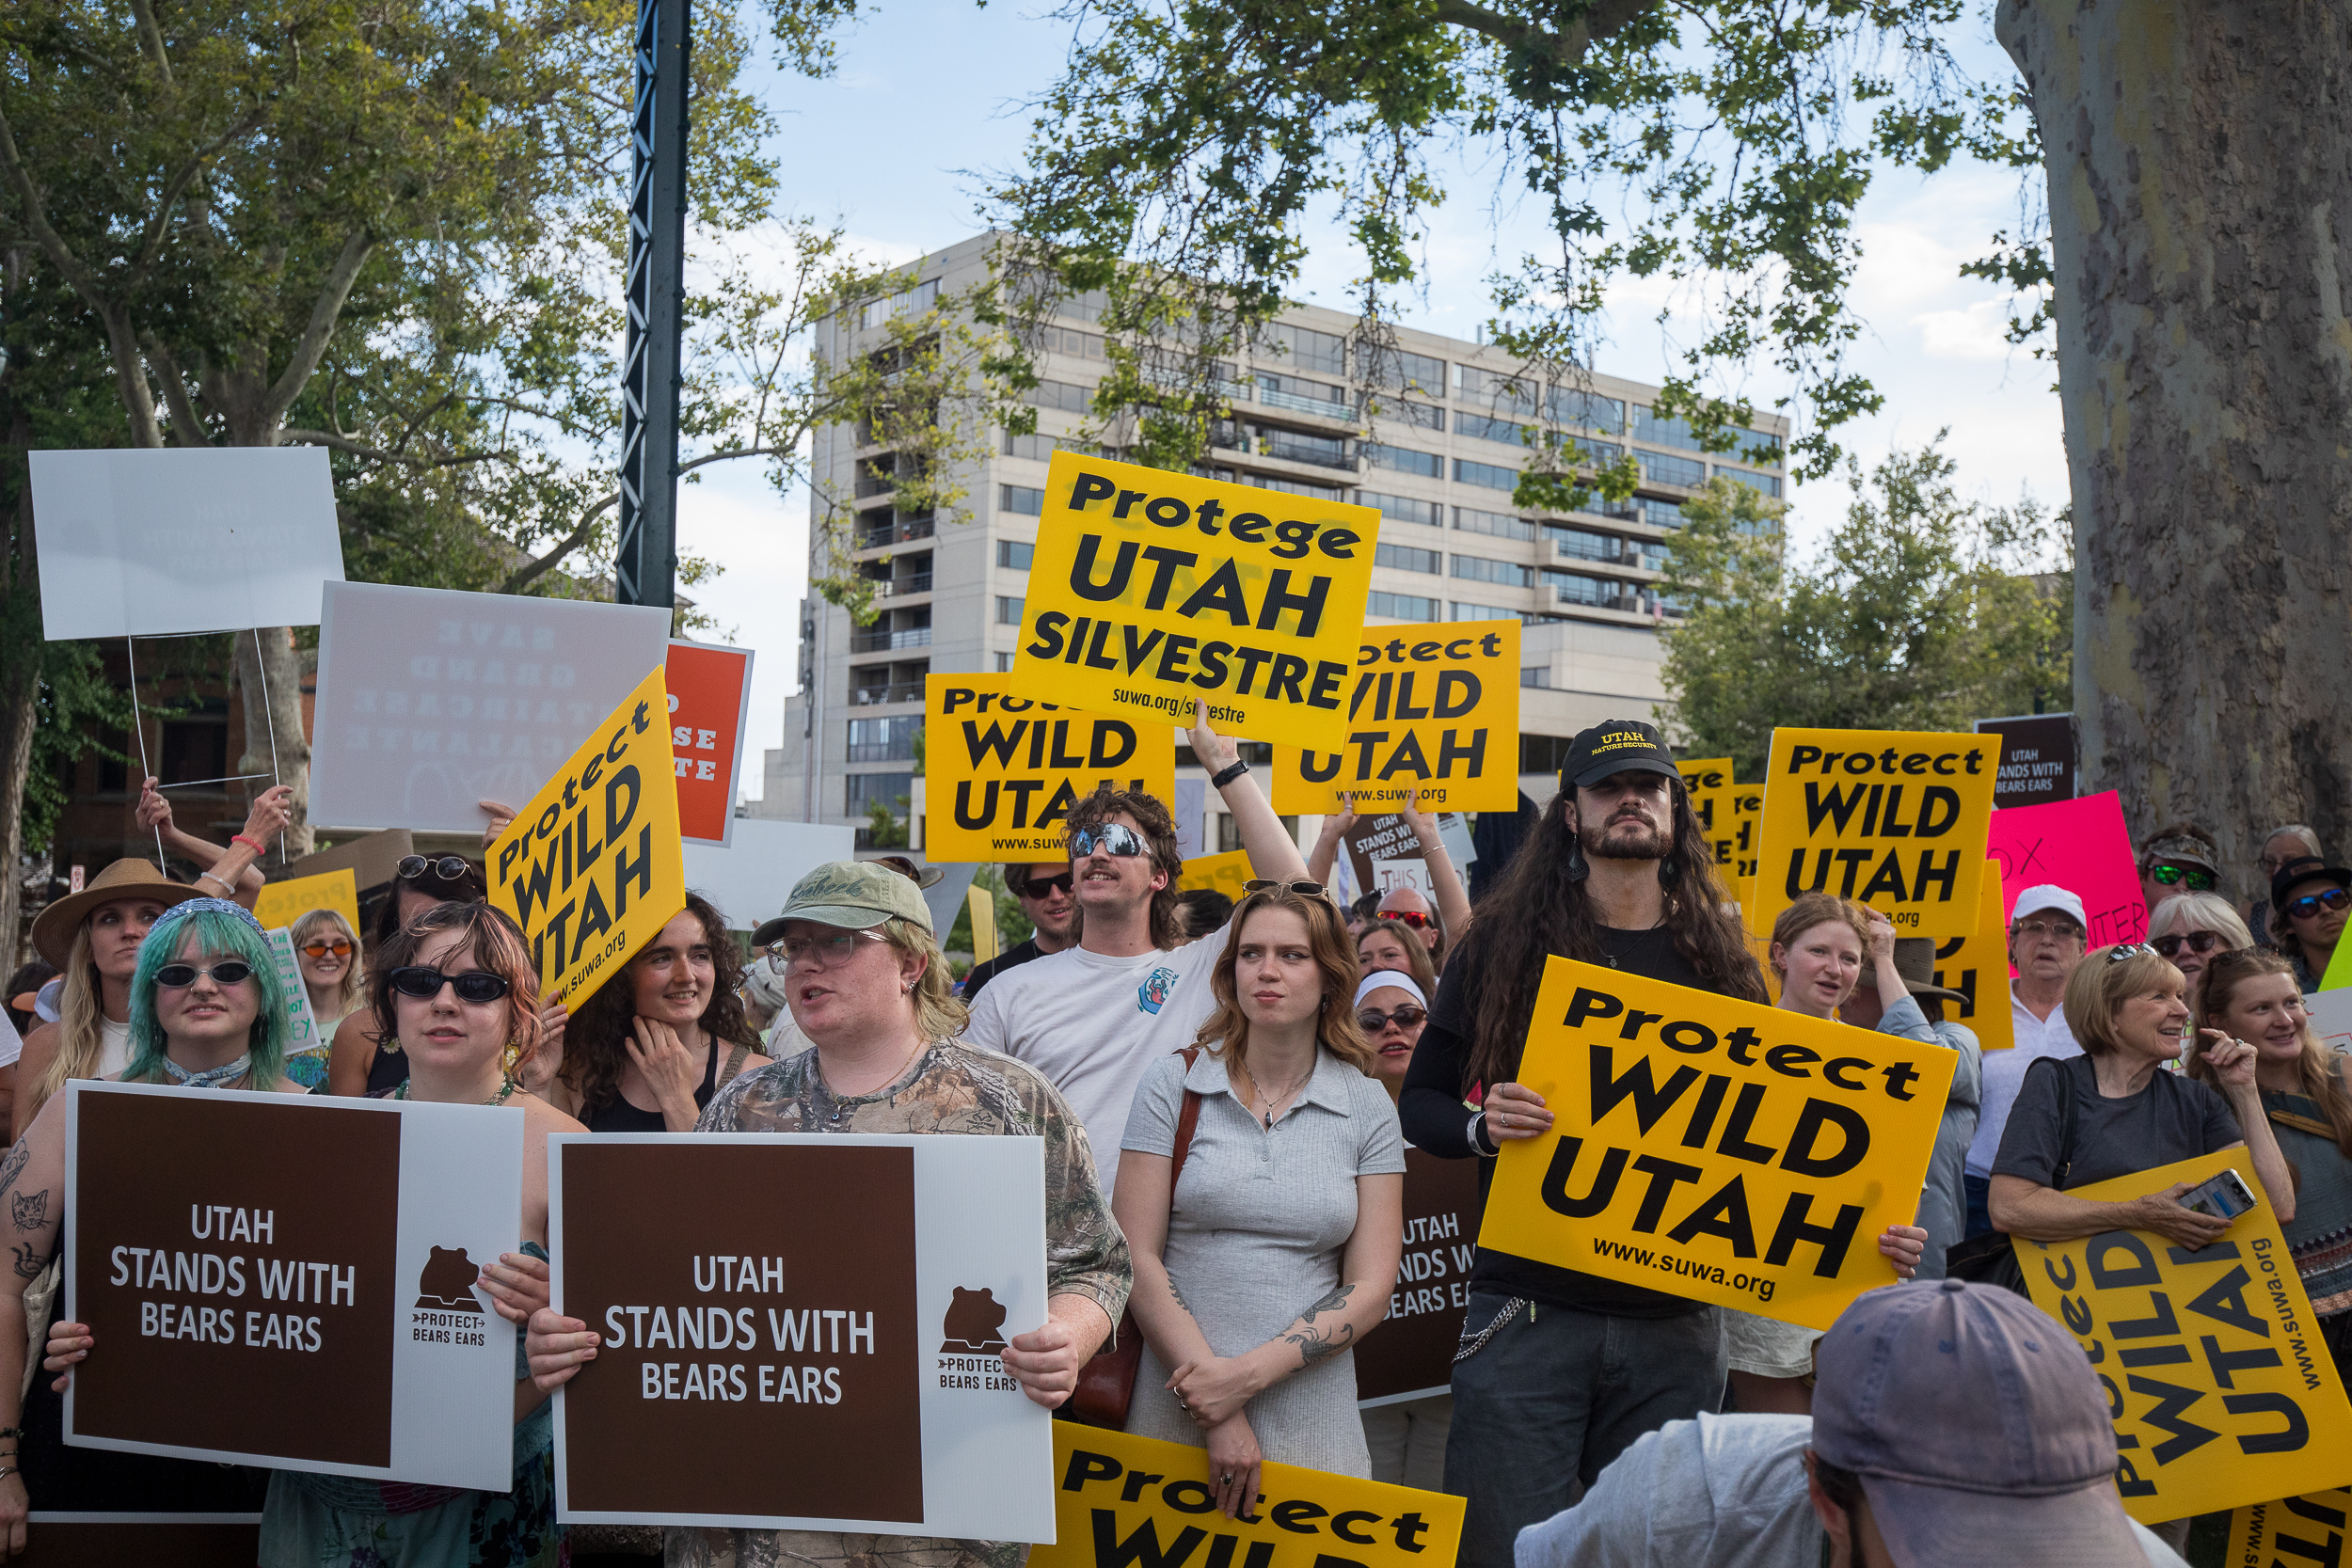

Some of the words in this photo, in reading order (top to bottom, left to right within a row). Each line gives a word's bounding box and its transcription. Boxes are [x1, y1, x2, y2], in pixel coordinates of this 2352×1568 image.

[1068, 472, 1360, 559] Protege
[1070, 533, 1332, 638] UTAH
[1025, 611, 1348, 709] SILVESTRE
[1358, 632, 1502, 665] otect
[961, 719, 1136, 771] WILD
[1300, 728, 1487, 783] UTAH
[1592, 742, 1622, 755] NATURE
[1601, 732, 1645, 743] UTAH
[1788, 745, 1983, 775] Protect
[2011, 749, 2038, 762] UTAH
[499, 699, 649, 888] Protect
[1995, 779, 2026, 793] BEARS
[2028, 778, 2053, 791] EARS
[1997, 763, 2029, 779] ANDS
[2031, 761, 2063, 777] WITH
[954, 777, 1144, 830] UTA
[1373, 814, 1398, 832] UTAH
[1804, 782, 1961, 838] WILD
[513, 765, 641, 930] WILD
[1356, 828, 1396, 854] STANDS
[1395, 824, 1412, 839] WI
[1397, 836, 1421, 853] EARS
[1381, 869, 1417, 890] THIS
[1786, 847, 1961, 903] UTAH
[558, 929, 626, 1003] w.suwa.org
[1563, 987, 1920, 1101] Protect
[1589, 1044, 1870, 1178] WILD
[191, 1204, 275, 1244] UTAH
[1403, 1212, 1459, 1244] UTAH
[1541, 1135, 1865, 1278] UTAH
[110, 1245, 246, 1298] STANDS
[258, 1259, 356, 1307] WITH
[693, 1256, 784, 1293] UTAH
[1594, 1237, 1775, 1304] www.suwa.org
[141, 1302, 233, 1344] BEARS
[245, 1312, 323, 1353] EARS
[413, 1328, 450, 1343] BEARS
[455, 1332, 485, 1346] EARS
[421, 1313, 478, 1329] PROTECT
[605, 1305, 756, 1350] STANDS
[769, 1308, 875, 1354] WITH
[2251, 1238, 2321, 1391] www.suwa.org
[947, 1357, 1005, 1373] PROTEC
[2086, 1229, 2222, 1467] WILD
[643, 1362, 748, 1402] BEARS
[759, 1366, 842, 1405] EARS
[940, 1375, 979, 1389] BEARS
[985, 1377, 1017, 1391] EARS
